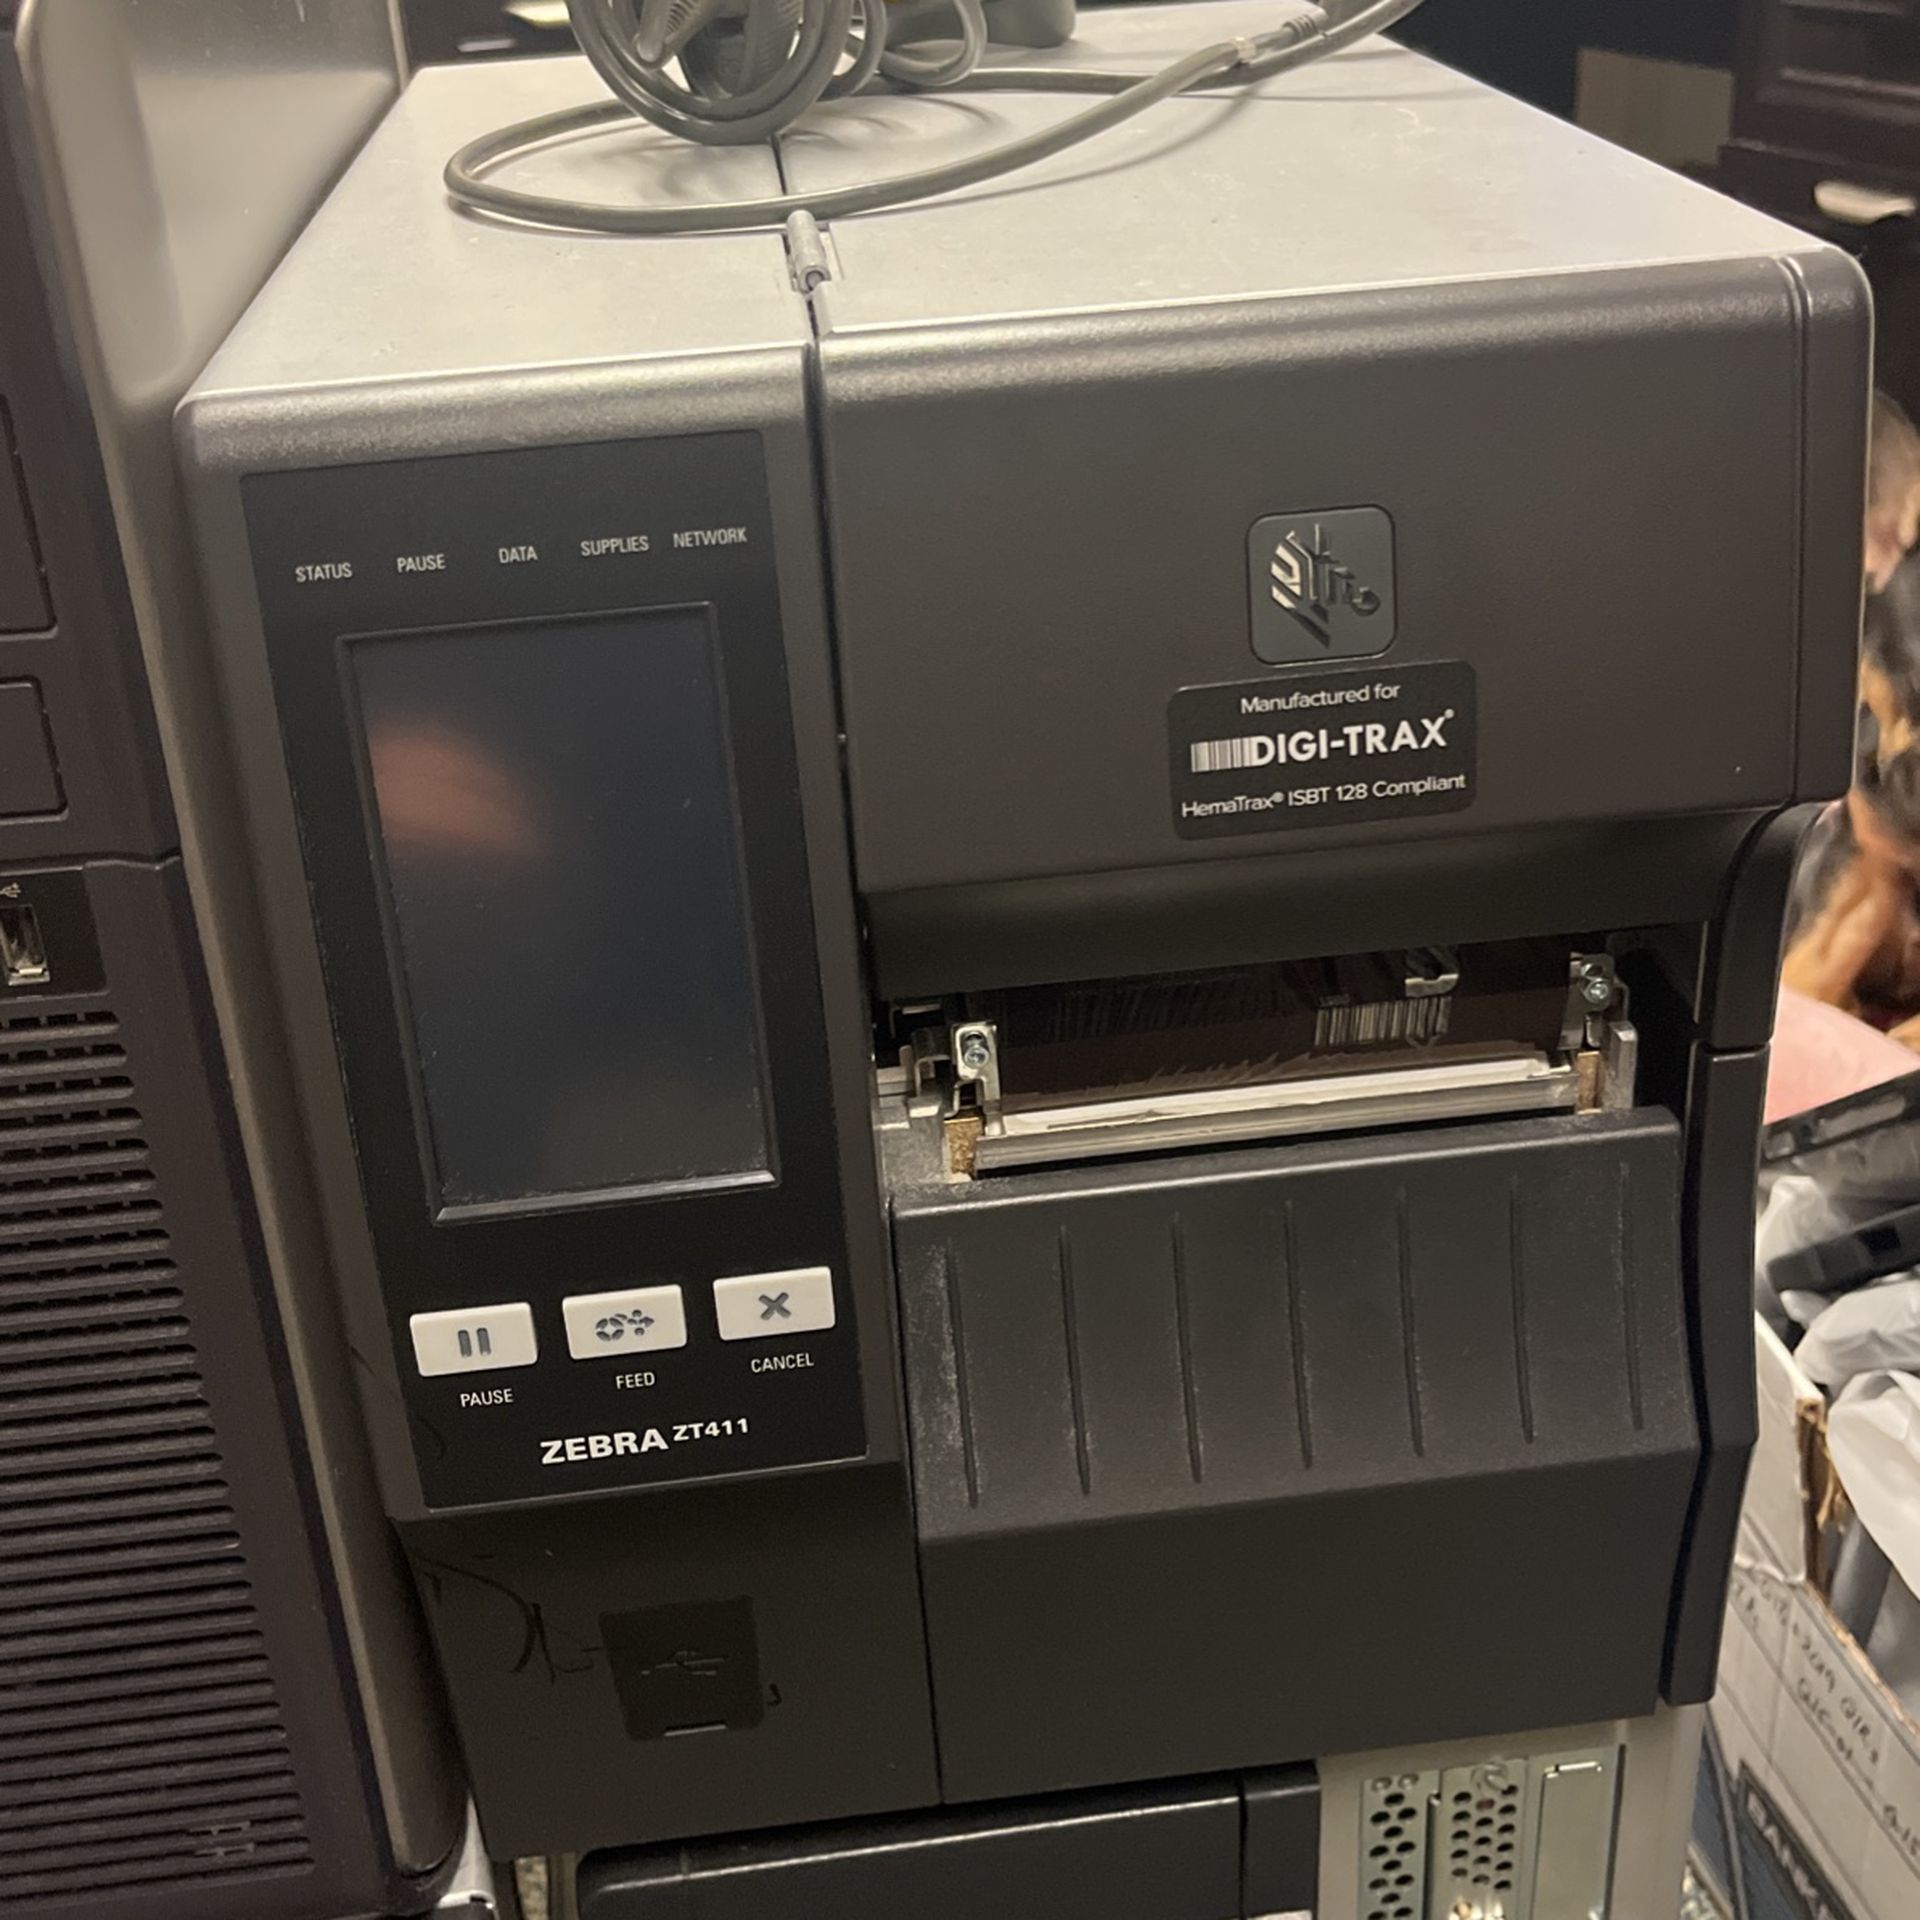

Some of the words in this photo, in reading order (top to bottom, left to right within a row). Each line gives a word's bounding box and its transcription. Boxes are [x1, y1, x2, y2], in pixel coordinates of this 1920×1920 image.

[580, 536, 650, 557] SUPPLIES
[673, 527, 748, 549] NETWORK
[396, 554, 446, 574] PAUSE
[498, 545, 538, 565] DATA
[295, 563, 353, 583] STATUS
[1240, 684, 1370, 715] Manufactured
[1374, 683, 1400, 701] for
[1288, 787, 1329, 806] ISBT
[1335, 782, 1368, 801] 128
[1372, 773, 1467, 799] Compliant
[750, 1353, 815, 1374] CANCEL
[615, 1371, 656, 1390] FEED
[460, 1388, 514, 1408] PAUSE
[540, 1428, 669, 1465] ZEBRA
[672, 1417, 750, 1442] ZT411
